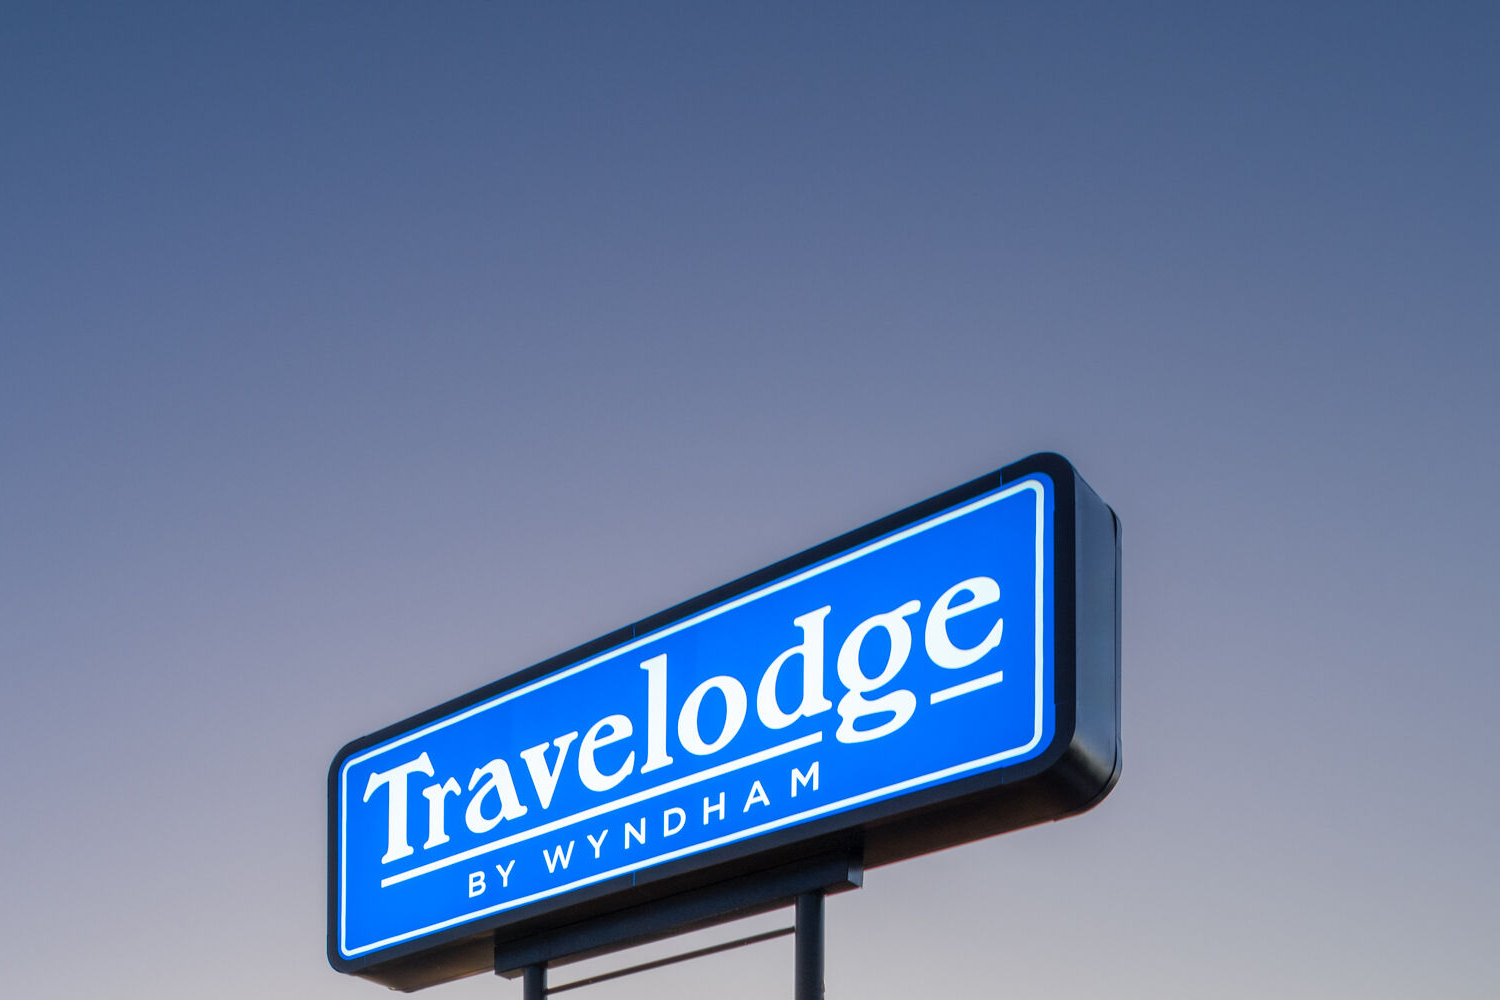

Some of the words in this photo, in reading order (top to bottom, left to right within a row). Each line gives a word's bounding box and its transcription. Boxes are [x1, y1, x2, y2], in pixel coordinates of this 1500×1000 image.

[363, 576, 1004, 865] Travelodge
[467, 859, 516, 898] BY
[542, 761, 820, 875] WYNDHAM
